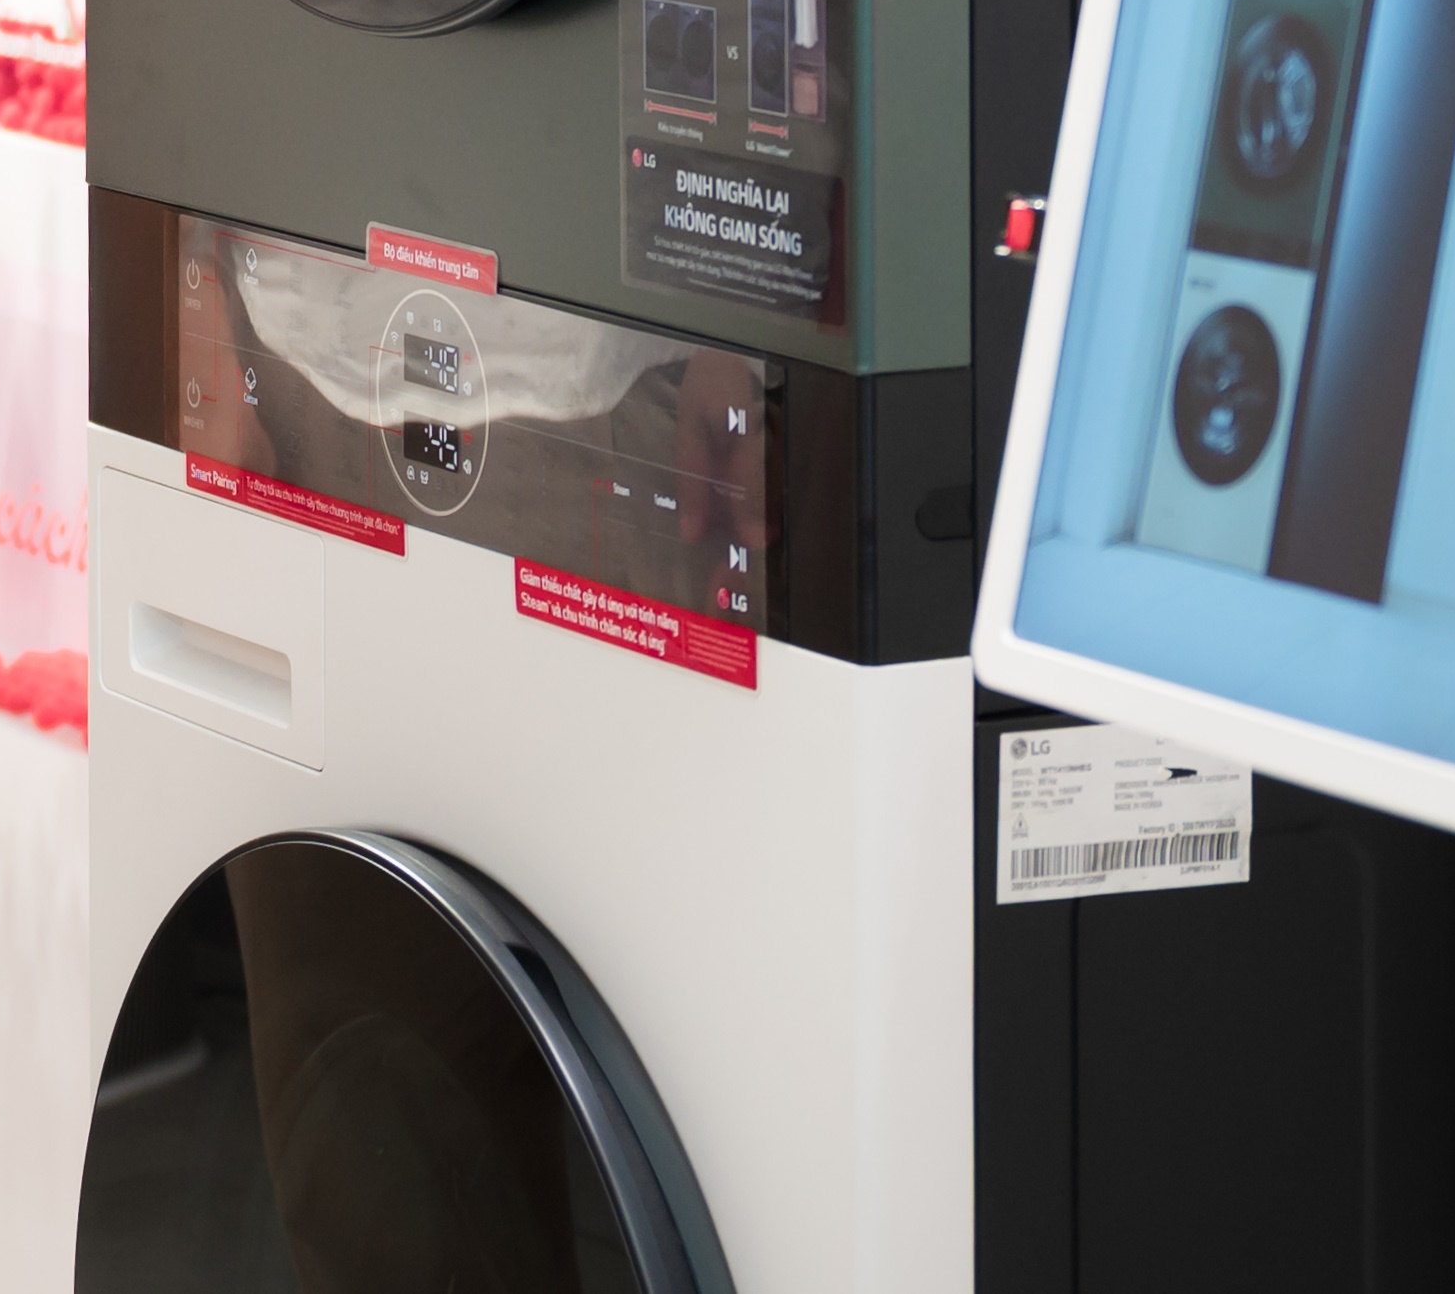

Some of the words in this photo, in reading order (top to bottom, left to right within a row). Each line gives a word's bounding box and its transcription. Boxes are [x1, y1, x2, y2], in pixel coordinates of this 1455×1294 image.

[676, 168, 713, 199] ĐỊNH
[715, 177, 764, 212] NGHĨA
[765, 188, 790, 219] LẠI
[664, 201, 717, 237] KHÔNG
[719, 216, 757, 246] GIAN
[758, 215, 803, 257] SỐNG
[383, 242, 396, 262] Bộ
[438, 257, 461, 280] trung
[190, 463, 212, 484] Smart
